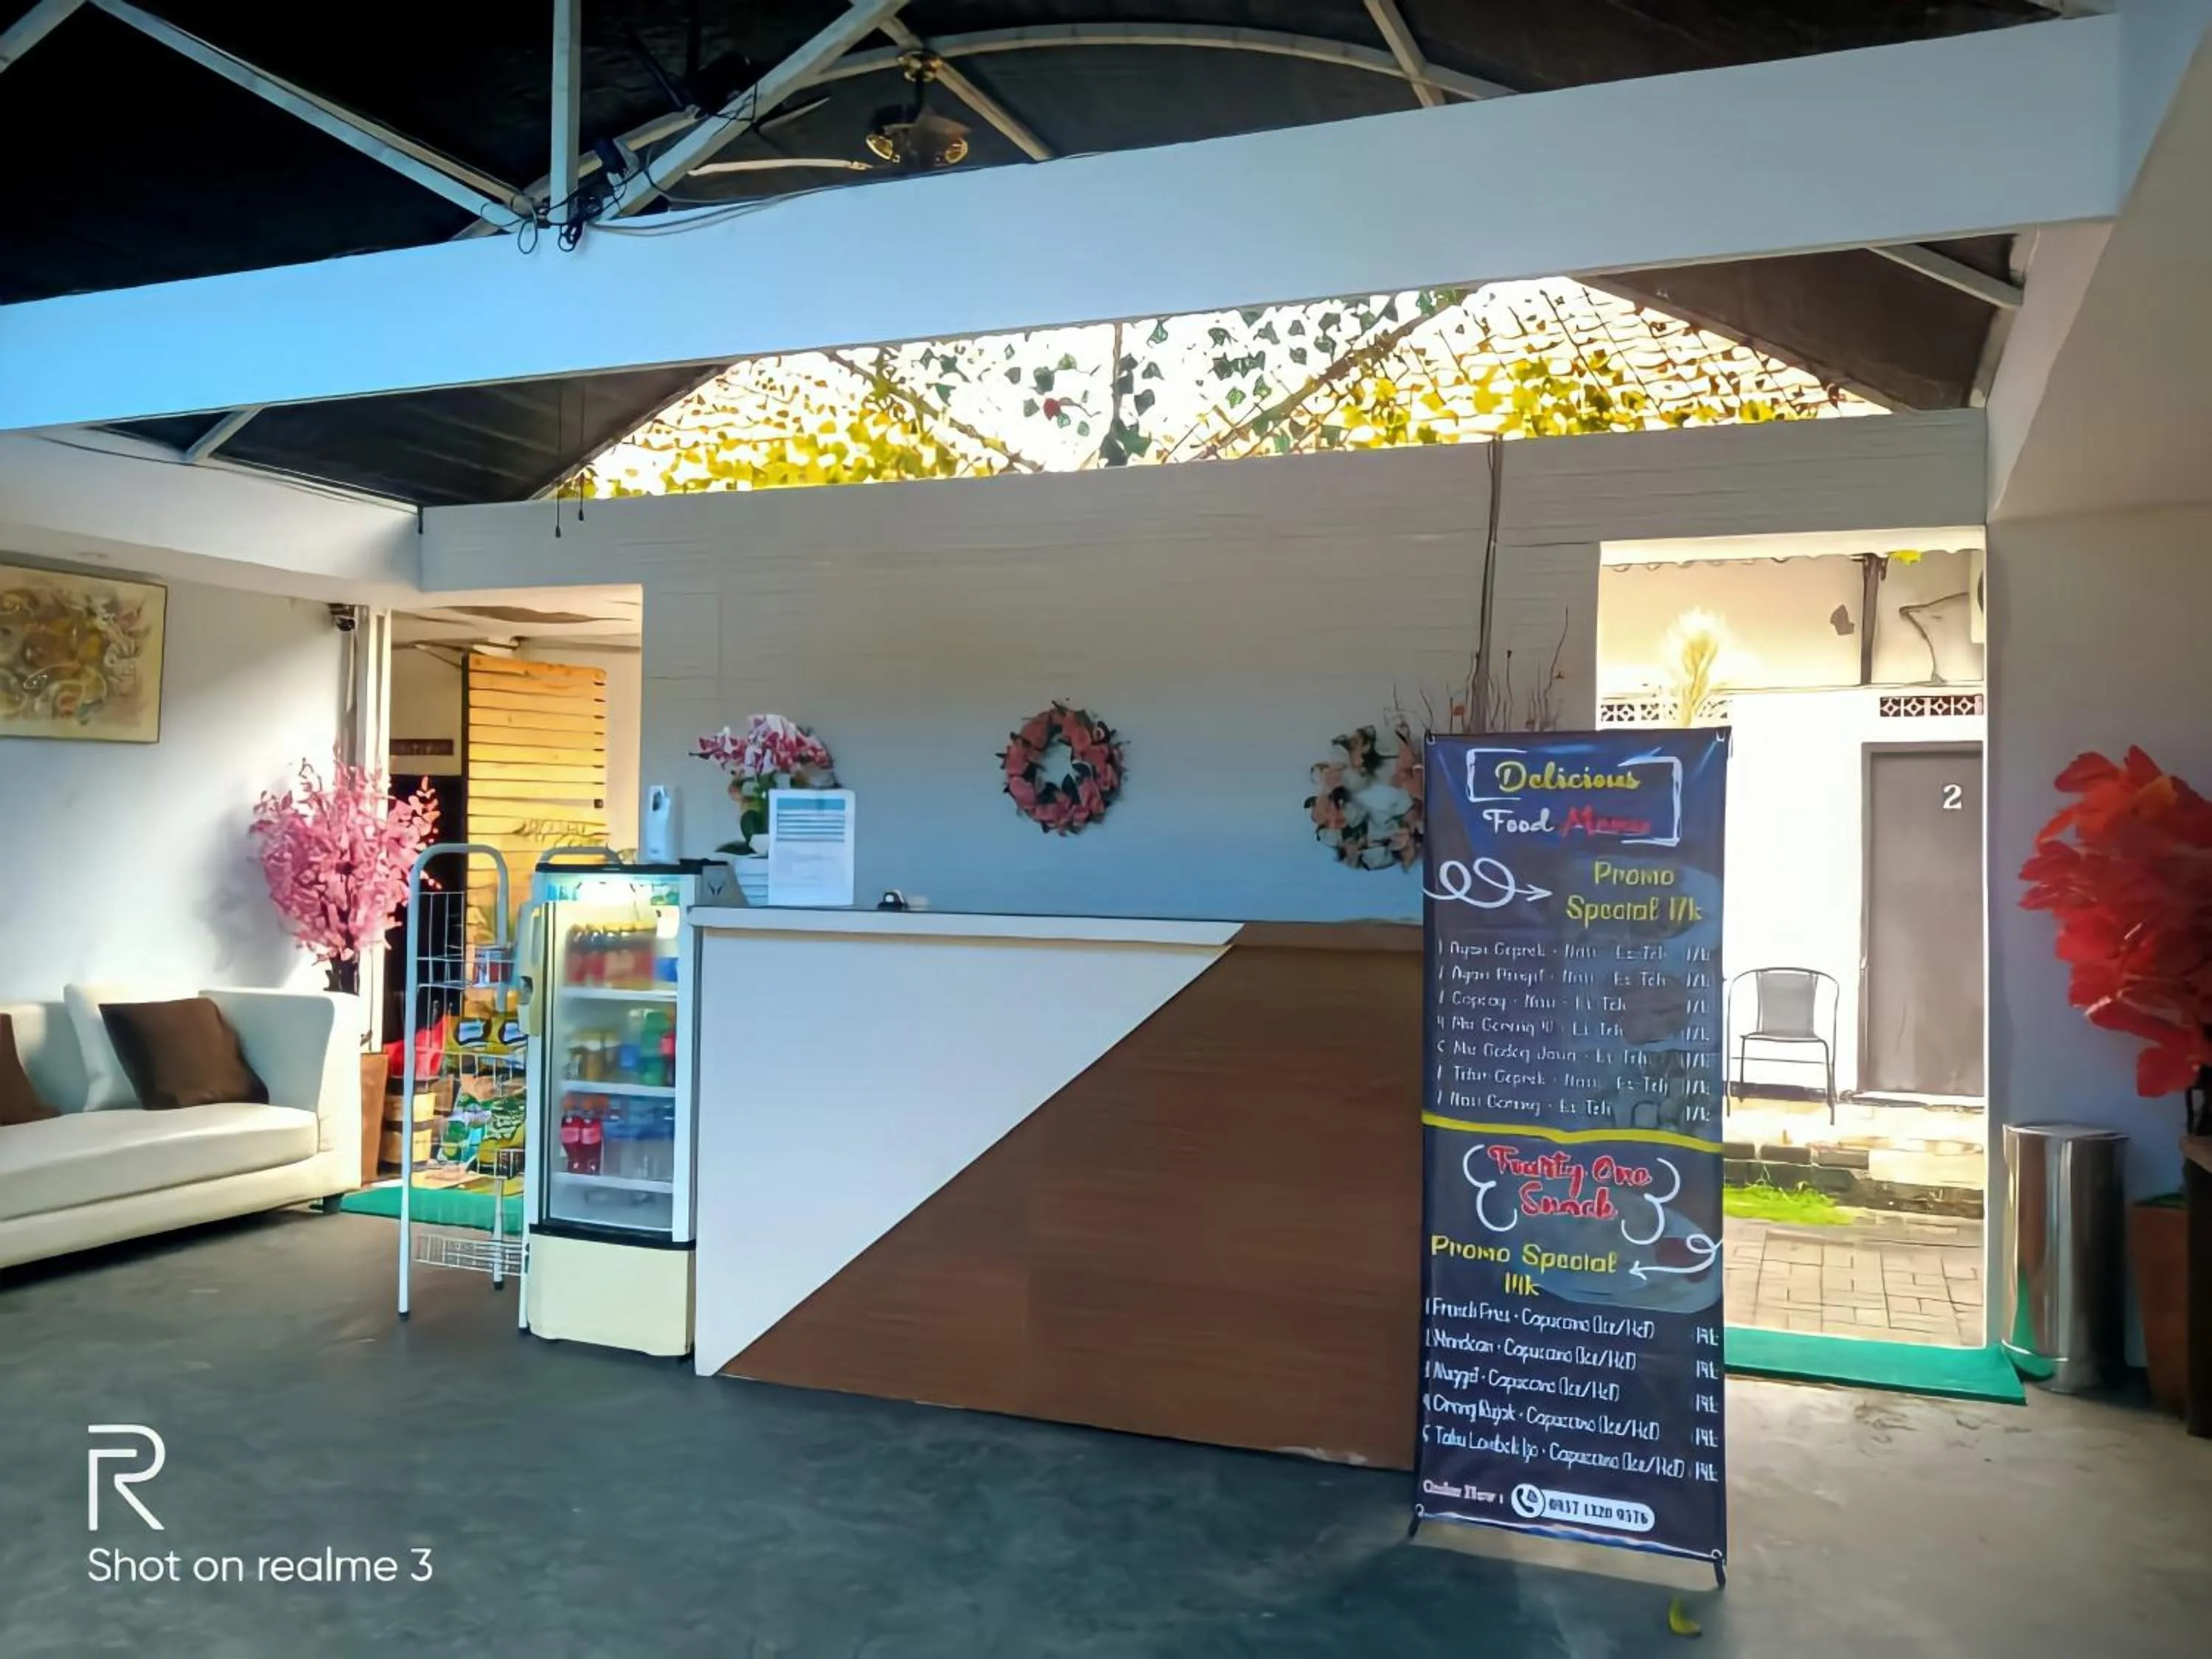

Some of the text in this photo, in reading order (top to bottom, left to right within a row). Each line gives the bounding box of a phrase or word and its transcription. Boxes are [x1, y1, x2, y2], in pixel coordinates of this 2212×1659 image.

[1495, 761, 1641, 793] Delicious
[1943, 784, 1962, 809] 2
[1482, 807, 1556, 835] Food
[1594, 860, 1675, 886] Promo
[1565, 894, 1660, 929] Special
[1431, 1234, 1617, 1275] Promo Special
